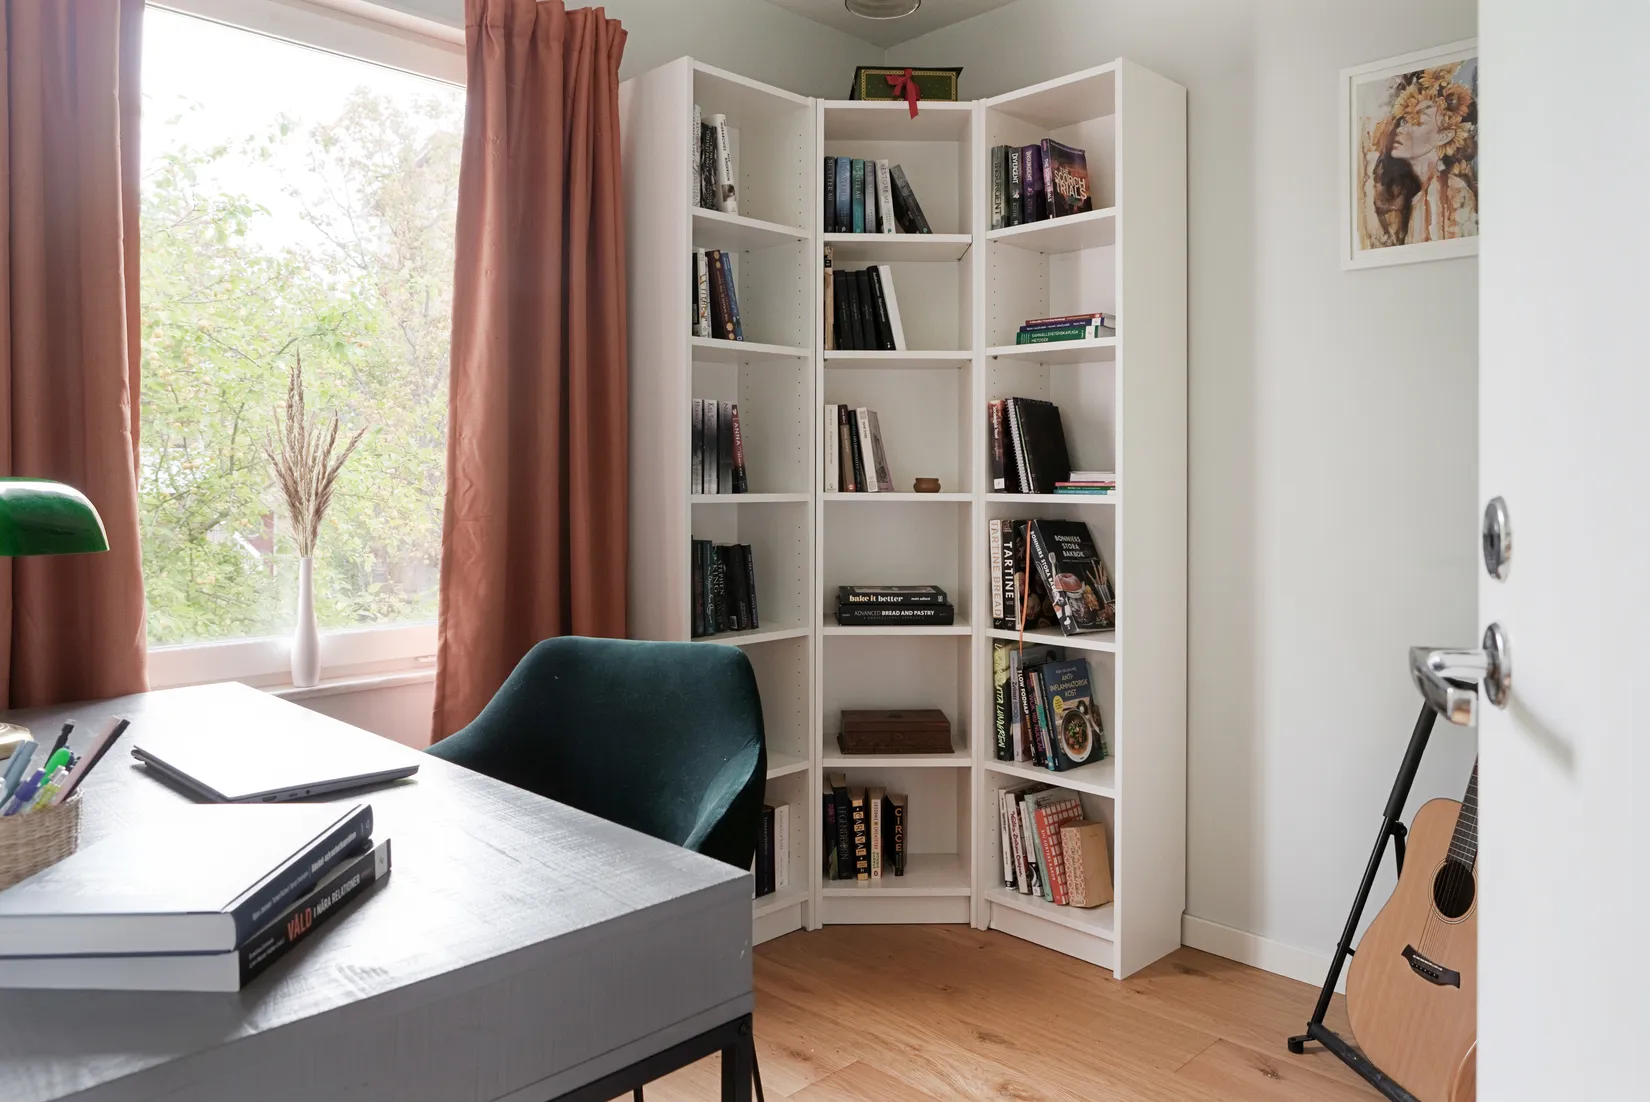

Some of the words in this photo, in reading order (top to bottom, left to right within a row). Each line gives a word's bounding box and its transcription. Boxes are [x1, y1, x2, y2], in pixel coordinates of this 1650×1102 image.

[880, 164, 888, 192] RESTORE
[994, 162, 1002, 216] INSURGENT
[1054, 170, 1086, 189] SCORCH
[1055, 179, 1088, 200] TRIALS
[991, 521, 1000, 572] TARTINE
[1030, 530, 1044, 558] BONNIERS
[1041, 559, 1051, 577] STORA
[1003, 542, 1014, 598] TARTINE
[993, 576, 1002, 616] BREAD
[1021, 688, 1029, 714] FODMAP
[1050, 678, 1088, 692] INFLAMMATORISK
[996, 706, 1006, 748] LUNDGREN
[838, 806, 848, 860] LEGENDBORN
[854, 812, 866, 856] CARAVAL
[1044, 840, 1052, 862] SORTERS
[287, 907, 312, 942] VÅLD
[317, 896, 331, 917] NÄRA
[332, 874, 361, 903] RELATIONER
